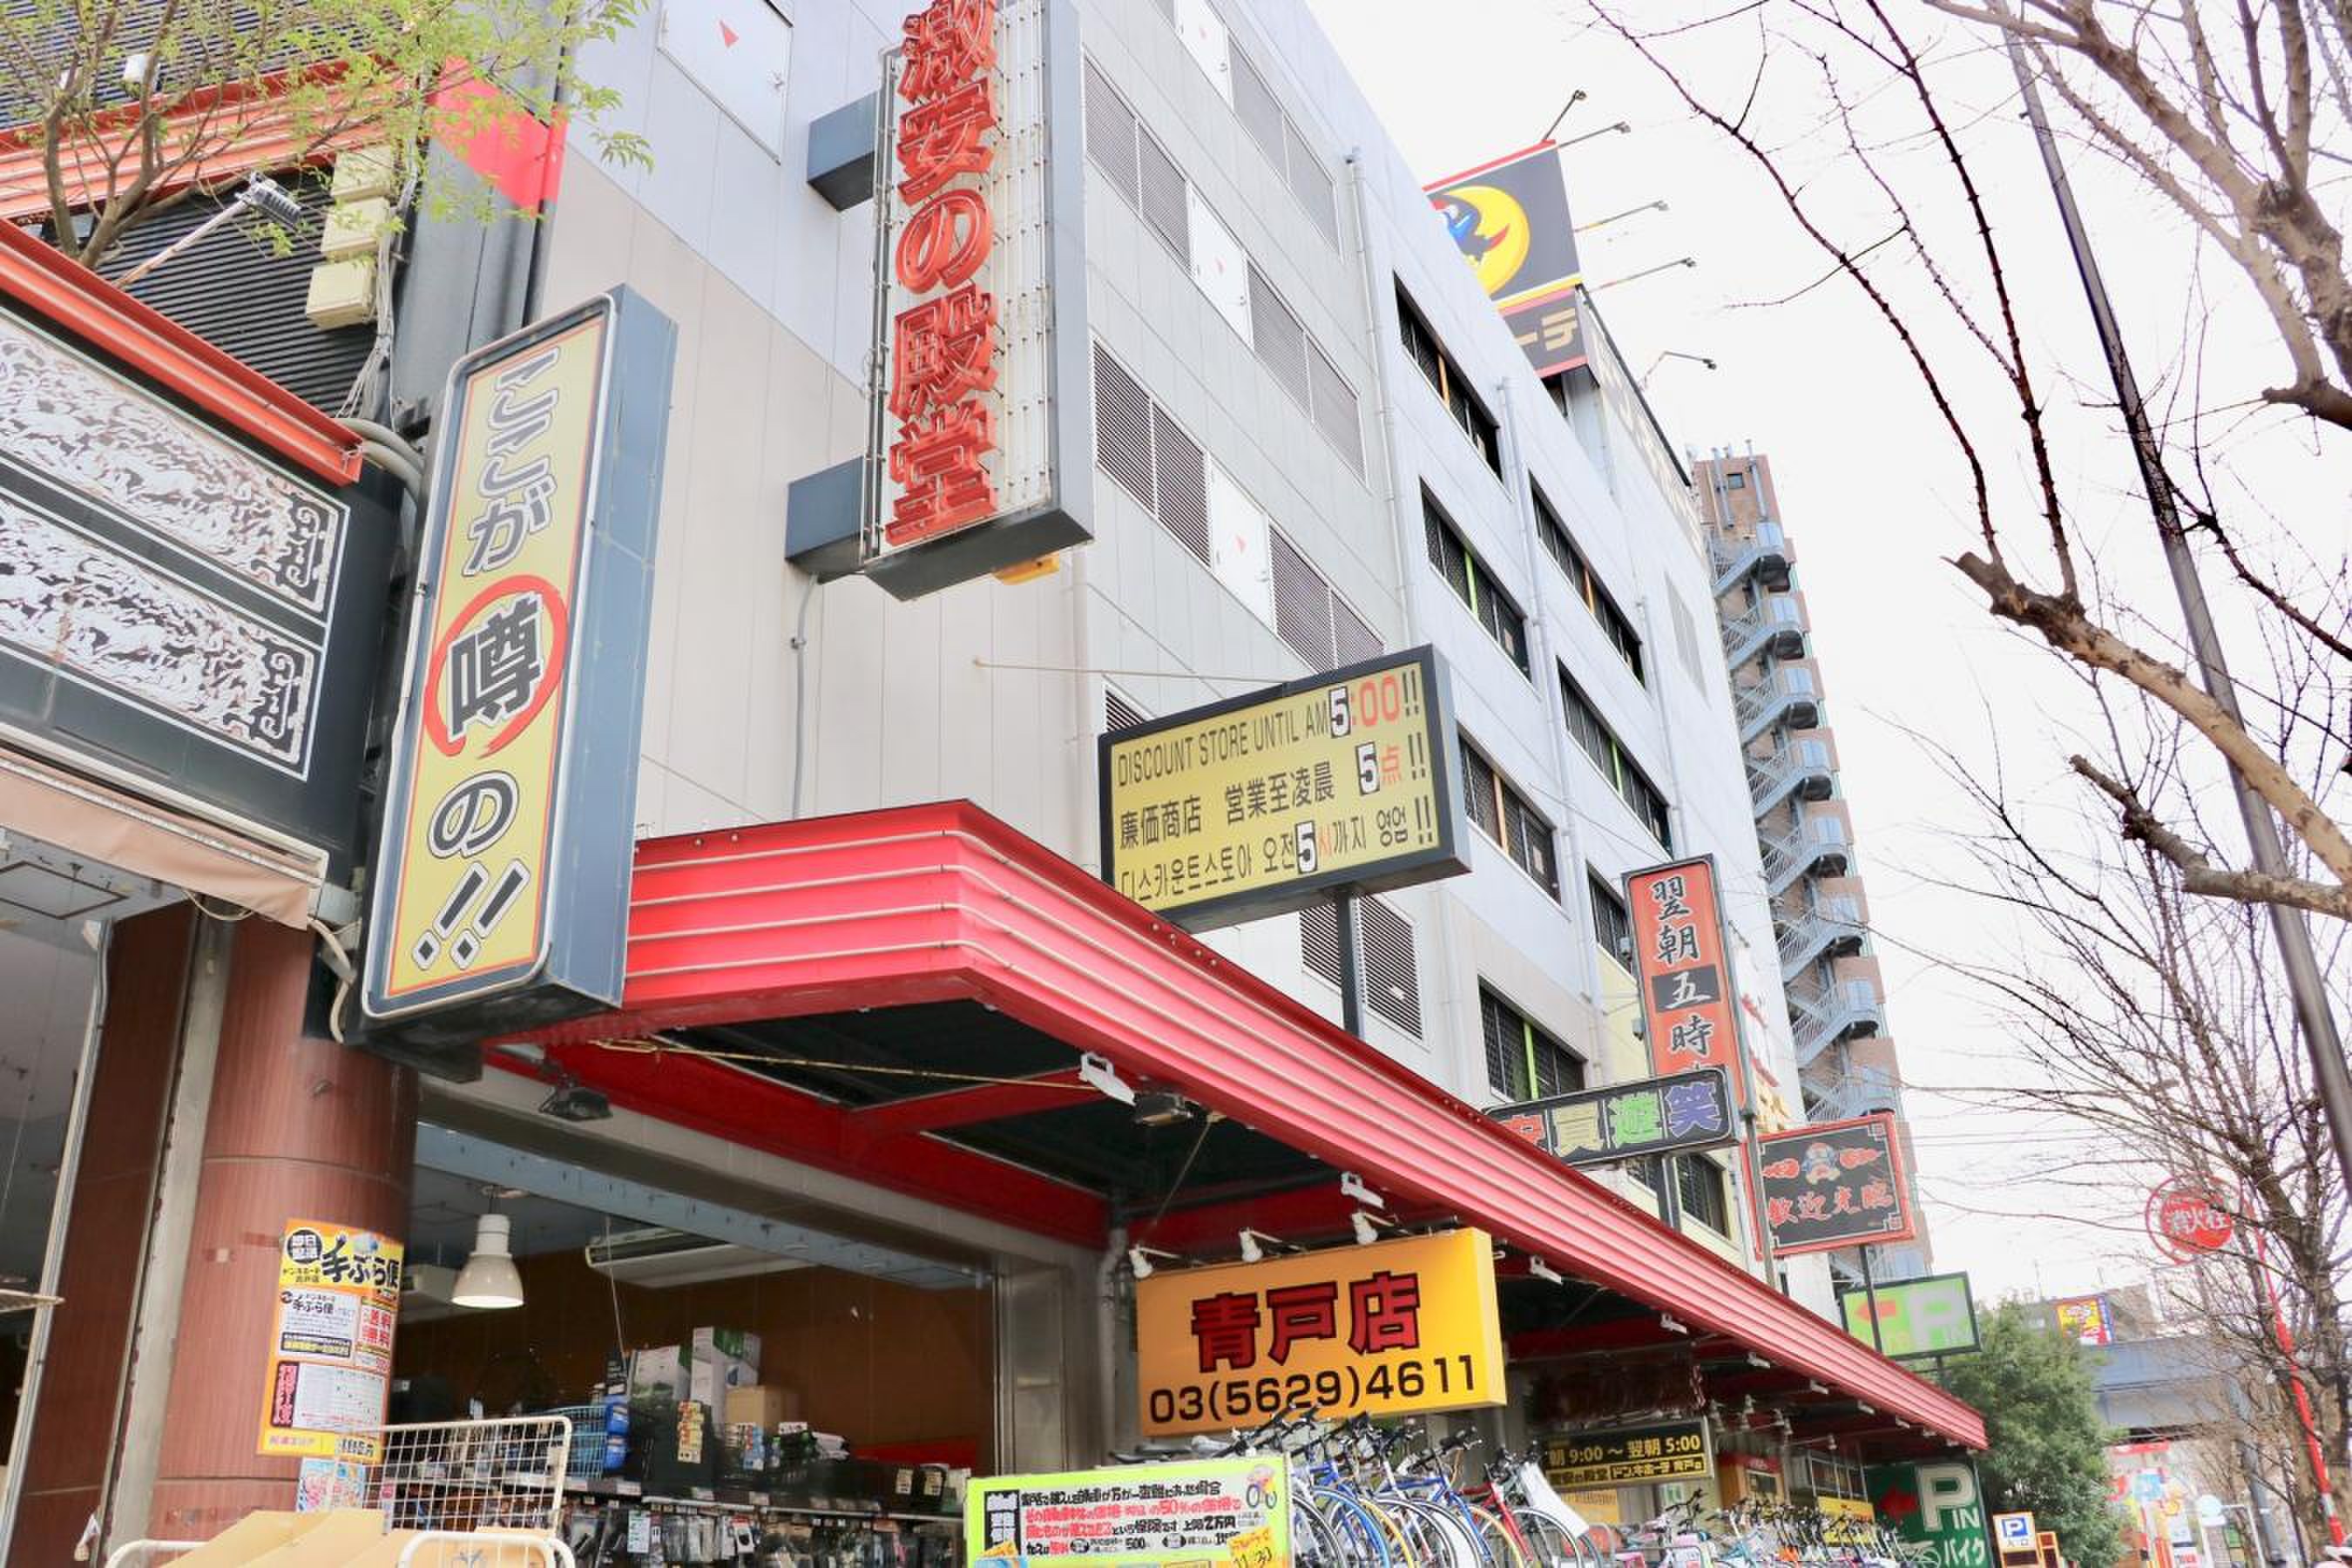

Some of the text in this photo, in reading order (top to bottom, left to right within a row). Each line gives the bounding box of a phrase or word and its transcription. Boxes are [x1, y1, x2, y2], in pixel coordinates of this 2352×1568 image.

[884, 0, 997, 547] 激安の殿堂
[1118, 745, 1193, 787] DISCOUNT
[1199, 727, 1249, 766] STORE
[1253, 711, 1300, 751] UNTIL
[1190, 1270, 1422, 1374] 青戸店
[1149, 1354, 1475, 1423] 03(5629)4611
[1921, 1464, 1977, 1531] P
[1952, 1506, 1981, 1531] IN
[2004, 1518, 2024, 1538] P
